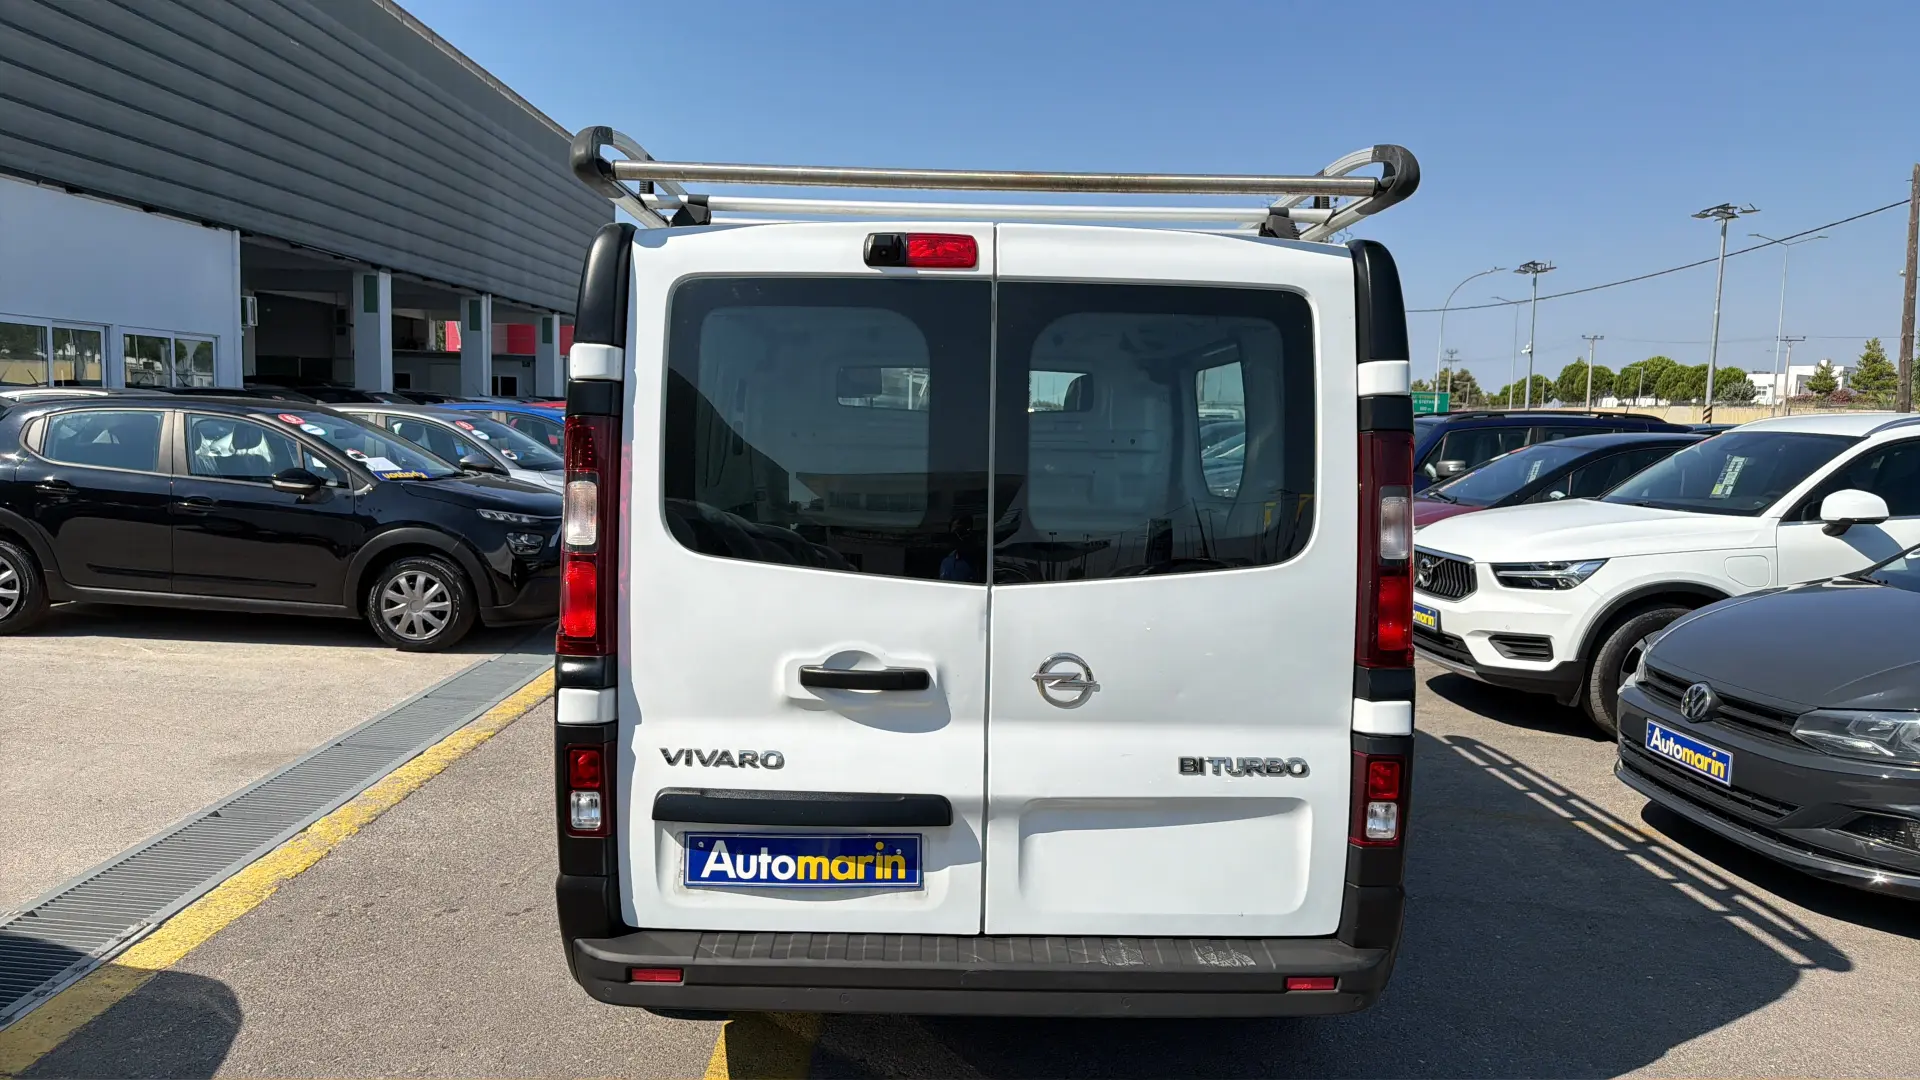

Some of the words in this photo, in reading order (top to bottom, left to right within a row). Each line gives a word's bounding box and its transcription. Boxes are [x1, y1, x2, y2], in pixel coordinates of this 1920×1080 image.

[659, 747, 785, 770] VIVARO
[1178, 756, 1310, 778] BITURBO
[1650, 727, 1725, 779] Automarin
[701, 839, 906, 880] Automarin
